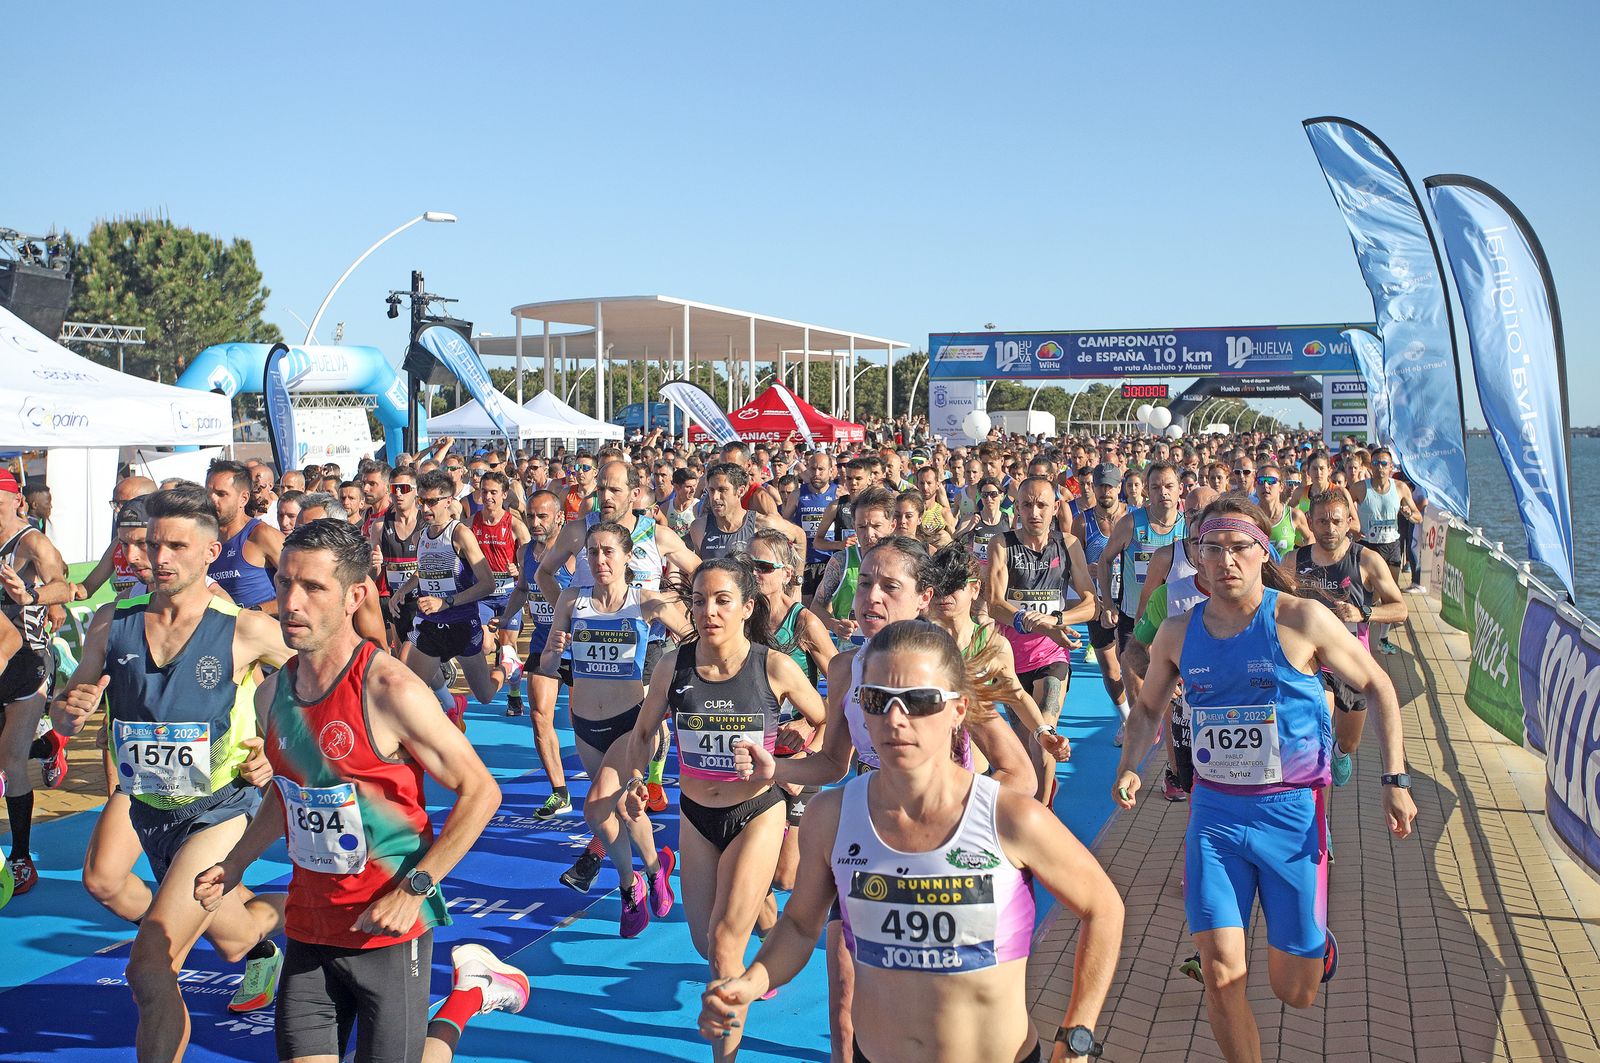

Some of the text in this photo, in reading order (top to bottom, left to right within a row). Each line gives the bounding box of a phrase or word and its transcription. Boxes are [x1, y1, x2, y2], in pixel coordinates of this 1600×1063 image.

[1077, 335, 1177, 348] CAMPEONATO
[1251, 341, 1293, 355] HUELVA
[1077, 346, 1213, 363] de ESPAÑA 10 km
[1039, 361, 1060, 369] WiHu
[1142, 363, 1176, 371] Absoluto
[1177, 364, 1183, 372] y
[1185, 362, 1213, 371] Master
[428, 581, 441, 591] 53
[535, 603, 554, 614] 266
[586, 644, 619, 661] 419
[586, 662, 620, 673] Joma
[1243, 710, 1267, 721] 2023
[174, 728, 200, 739] 2023
[1204, 727, 1263, 750] 1629
[128, 743, 194, 767] 1576
[1229, 770, 1252, 779] Syrluz
[316, 791, 347, 805] 2023
[309, 855, 333, 866] Syrluz
[837, 857, 868, 866] VIATOR
[897, 878, 975, 890] RUNNING
[917, 893, 962, 904] LOOP
[880, 909, 957, 943] 490
[881, 946, 963, 969] Joma
